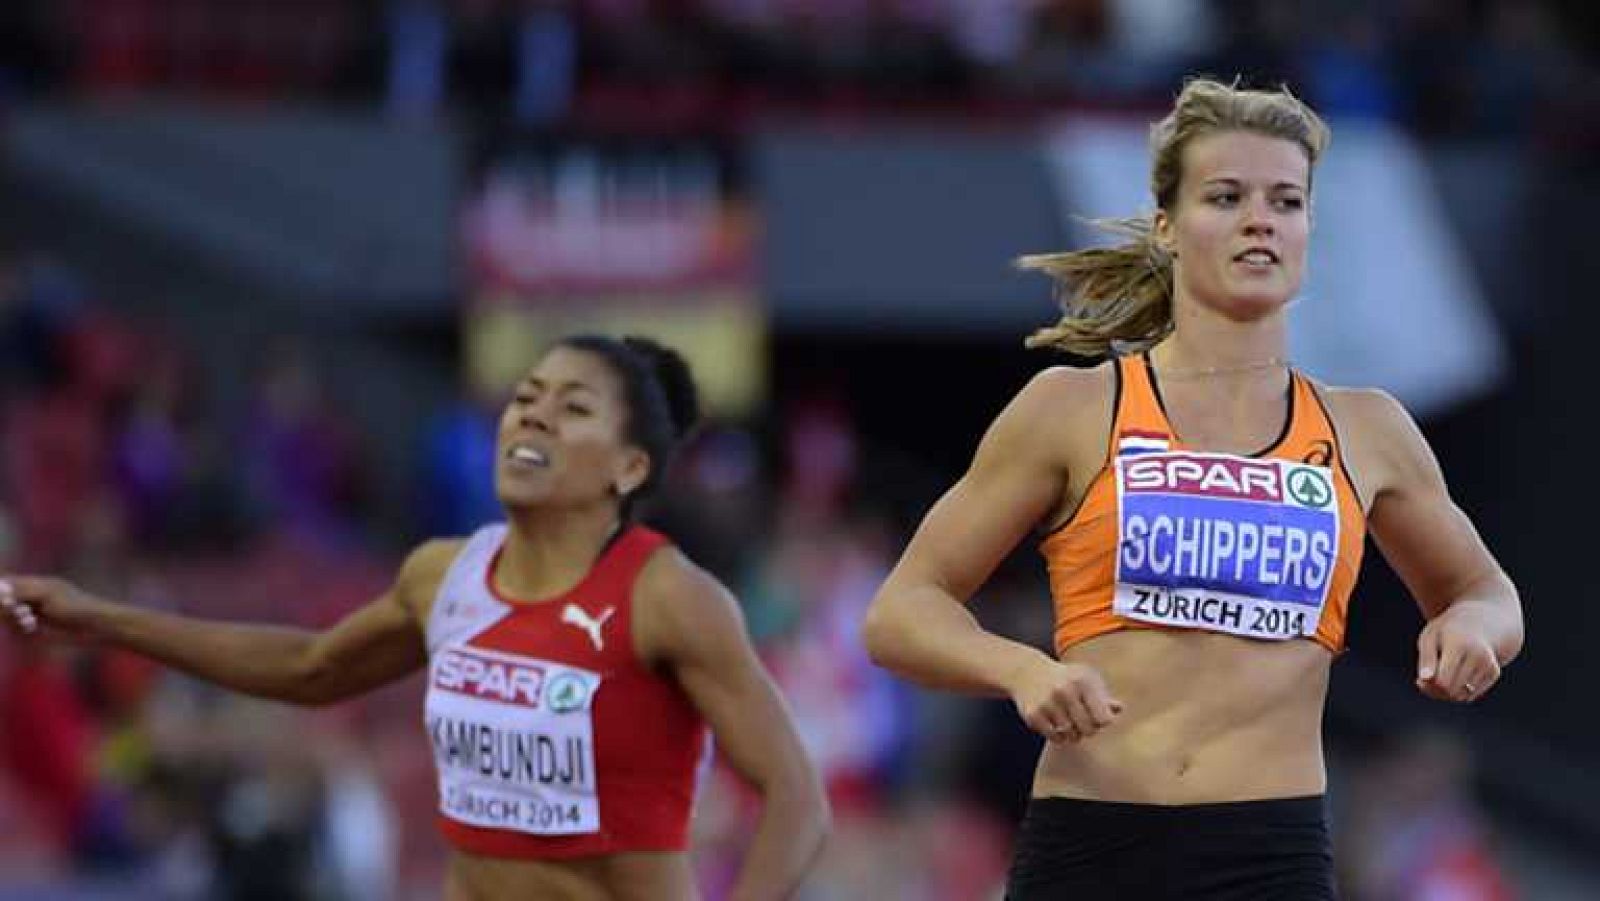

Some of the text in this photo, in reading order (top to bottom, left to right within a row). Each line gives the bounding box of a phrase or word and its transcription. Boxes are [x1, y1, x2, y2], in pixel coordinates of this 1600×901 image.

[1128, 461, 1279, 496] SPAR
[1124, 515, 1331, 589] SCHIPPERS
[1132, 590, 1305, 636] ZÜRICH 2014
[436, 653, 541, 705] SPAR
